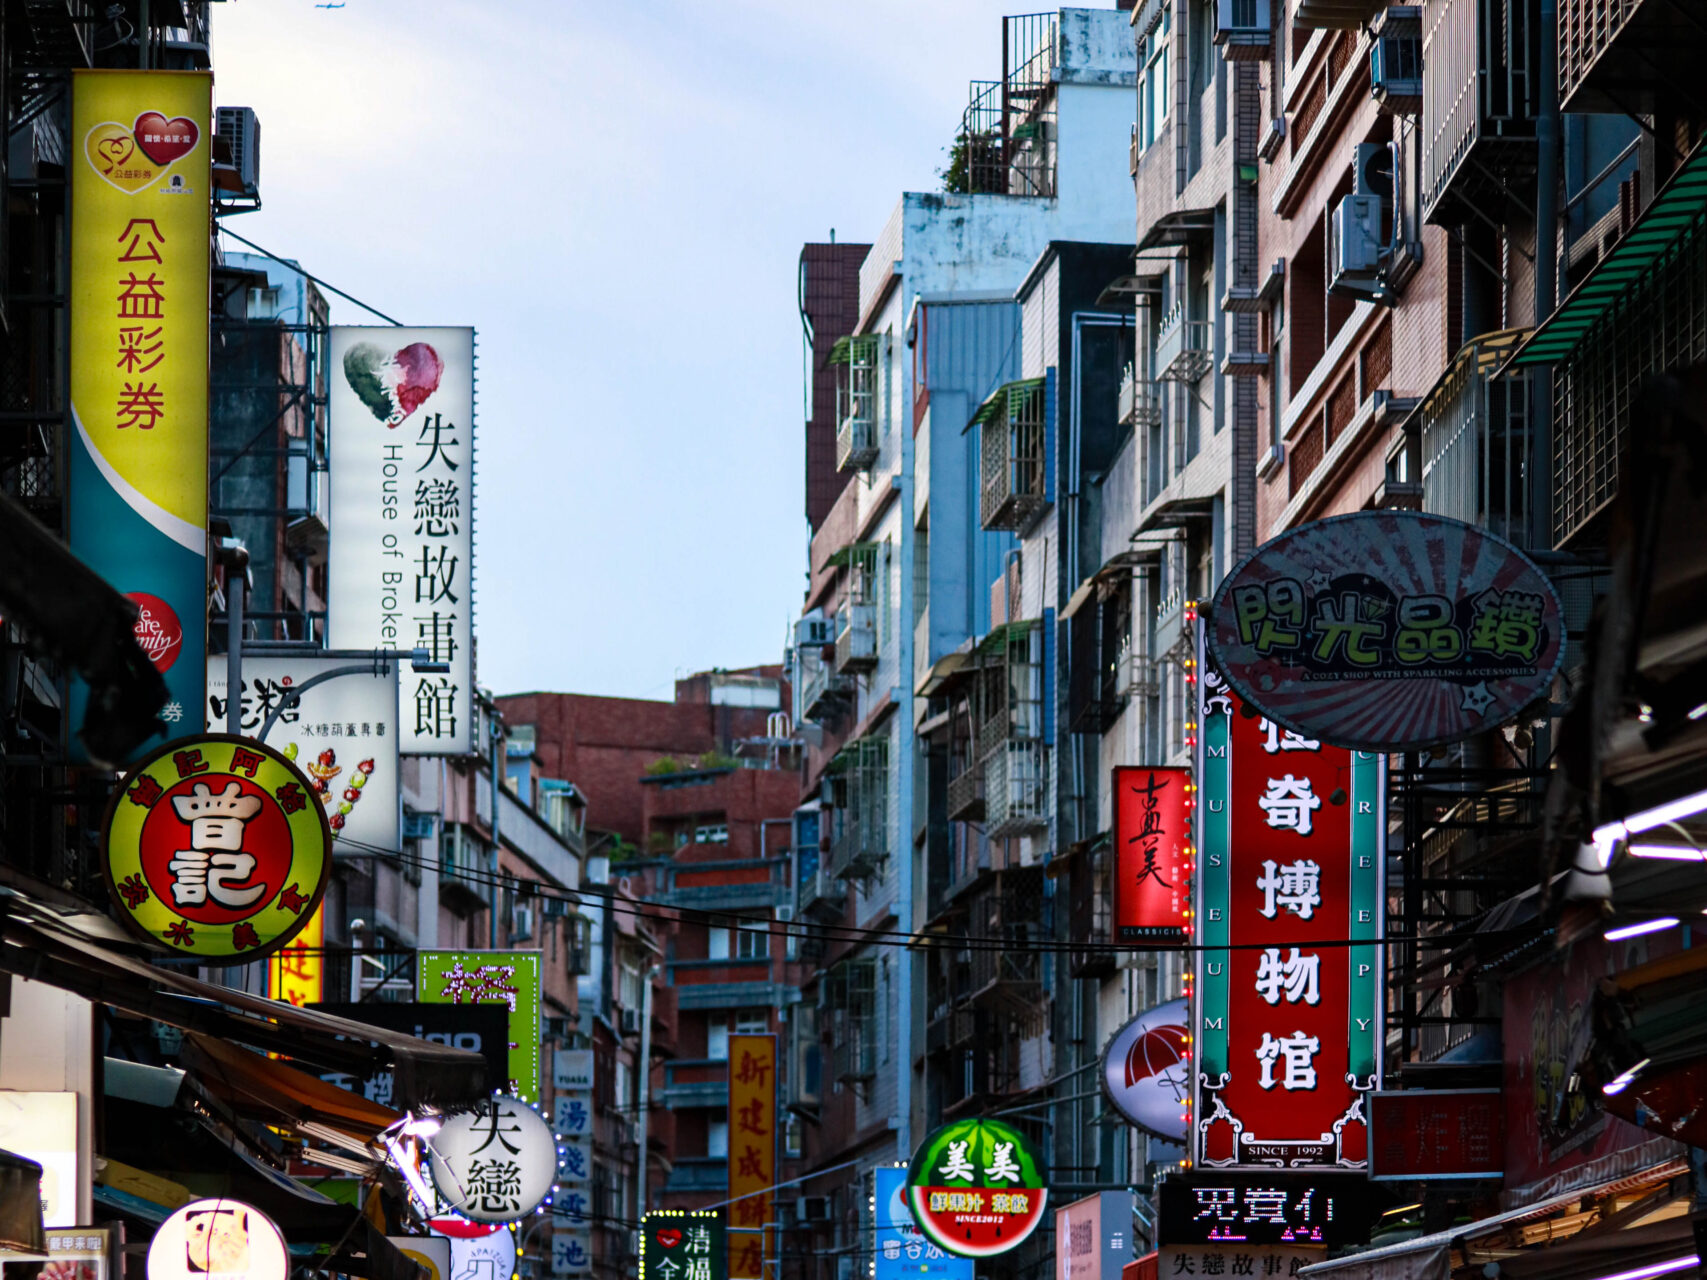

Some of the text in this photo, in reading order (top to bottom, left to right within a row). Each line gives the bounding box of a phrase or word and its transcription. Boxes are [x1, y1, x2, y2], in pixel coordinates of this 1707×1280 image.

[114, 170, 151, 179] 公益彩券
[117, 218, 165, 430] 公益彩券
[382, 445, 403, 520] House
[382, 534, 403, 558] of
[413, 412, 459, 738] 失戀故事館
[1230, 577, 1545, 667] 閃光晶鑽
[1302, 671, 1312, 681] A
[1342, 670, 1371, 680] SHOP
[1373, 669, 1400, 679] WITH
[1402, 668, 1463, 678] SPARKLING
[1465, 666, 1537, 676] ACCESSORIES
[168, 781, 267, 910] 曾記
[1204, 745, 1226, 1030] MUSEUM
[1122, 927, 1182, 936] CLASSICIS
[466, 1102, 522, 1212] 失戀
[735, 1050, 771, 1276] 新建成餅店
[938, 1140, 1021, 1182] 美美
[1248, 1146, 1323, 1156] SINCE 1992
[929, 1192, 1029, 1213] 鮮果汁 茶飲
